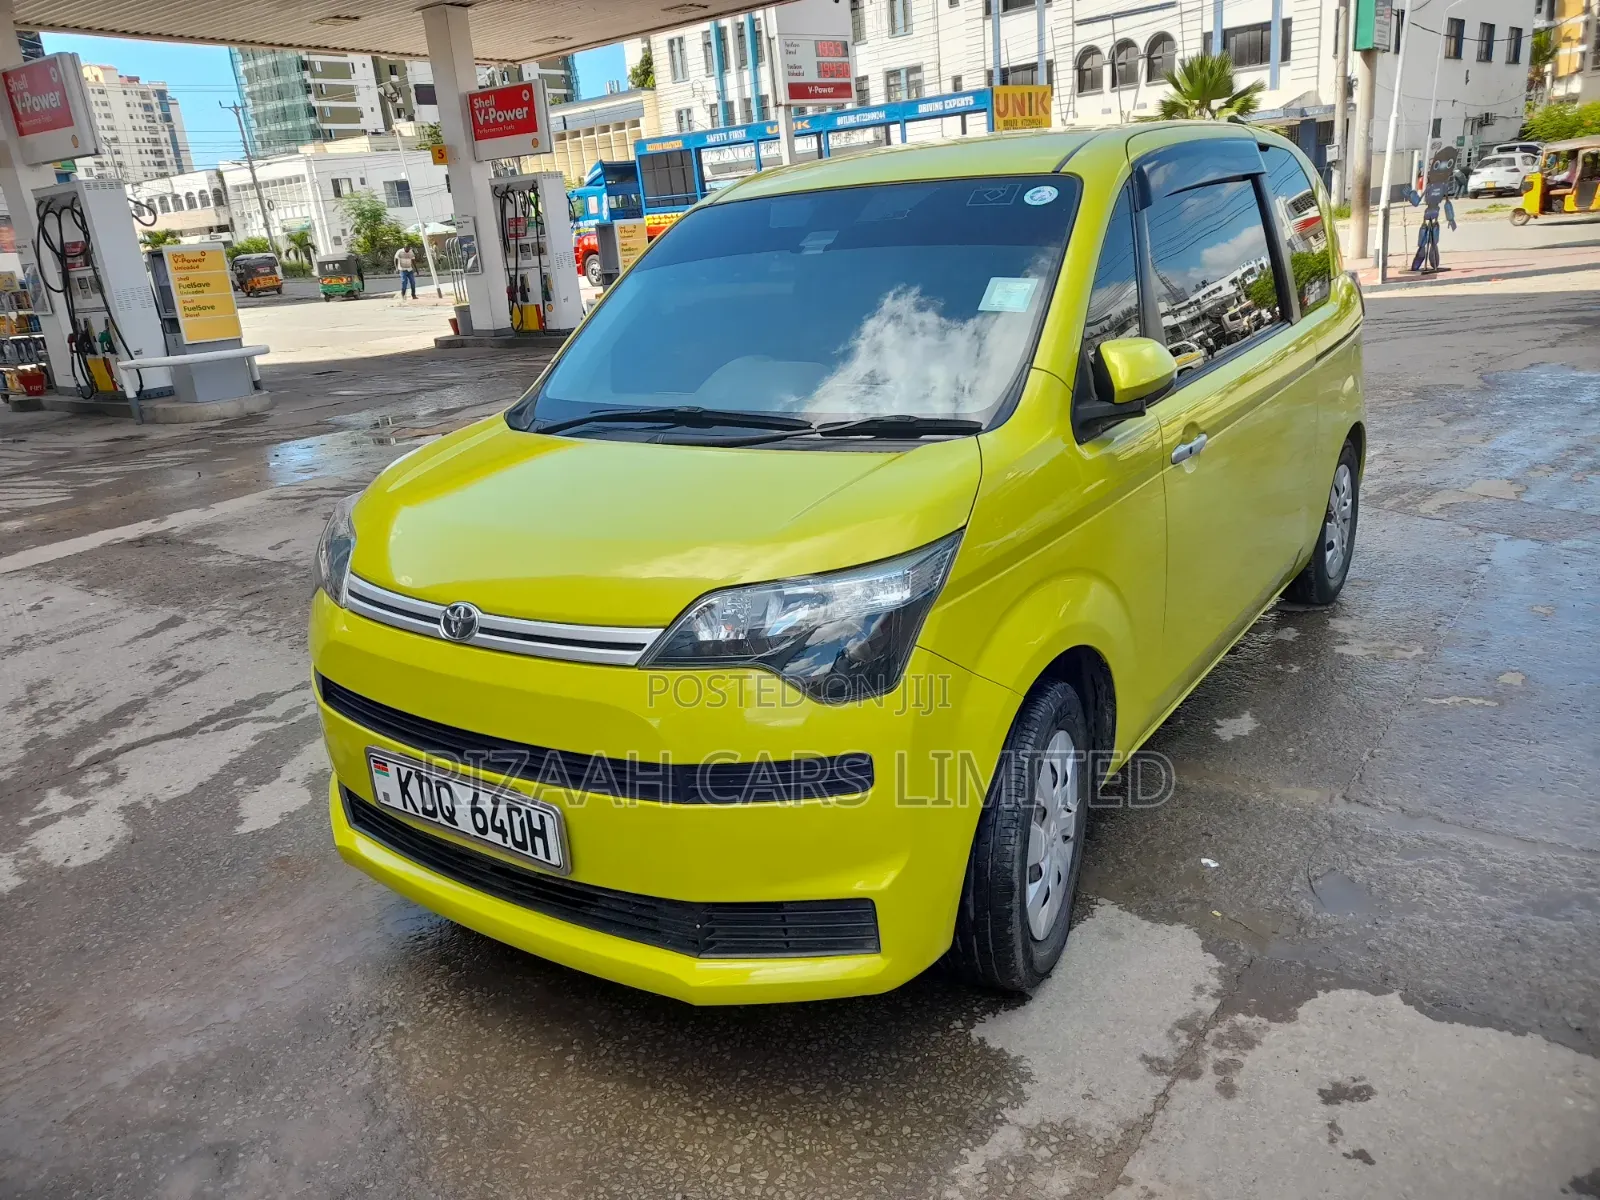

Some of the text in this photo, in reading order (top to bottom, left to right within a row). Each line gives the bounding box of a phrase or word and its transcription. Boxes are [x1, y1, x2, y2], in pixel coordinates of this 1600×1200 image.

[7, 73, 28, 92] Shell
[808, 86, 834, 94] V-Power
[12, 90, 61, 115] V-Power
[473, 94, 496, 109] Shell
[918, 96, 974, 114] DRIVING EXPERTS
[995, 91, 1050, 118] UNIK
[475, 106, 529, 126] V-Power
[766, 119, 811, 134] UIK
[706, 129, 747, 143] SAFETY FIRST
[437, 149, 445, 159] 5
[178, 281, 211, 289] FuelSave
[183, 304, 215, 312] FuelSave
[396, 766, 551, 861] KDQ 640H
